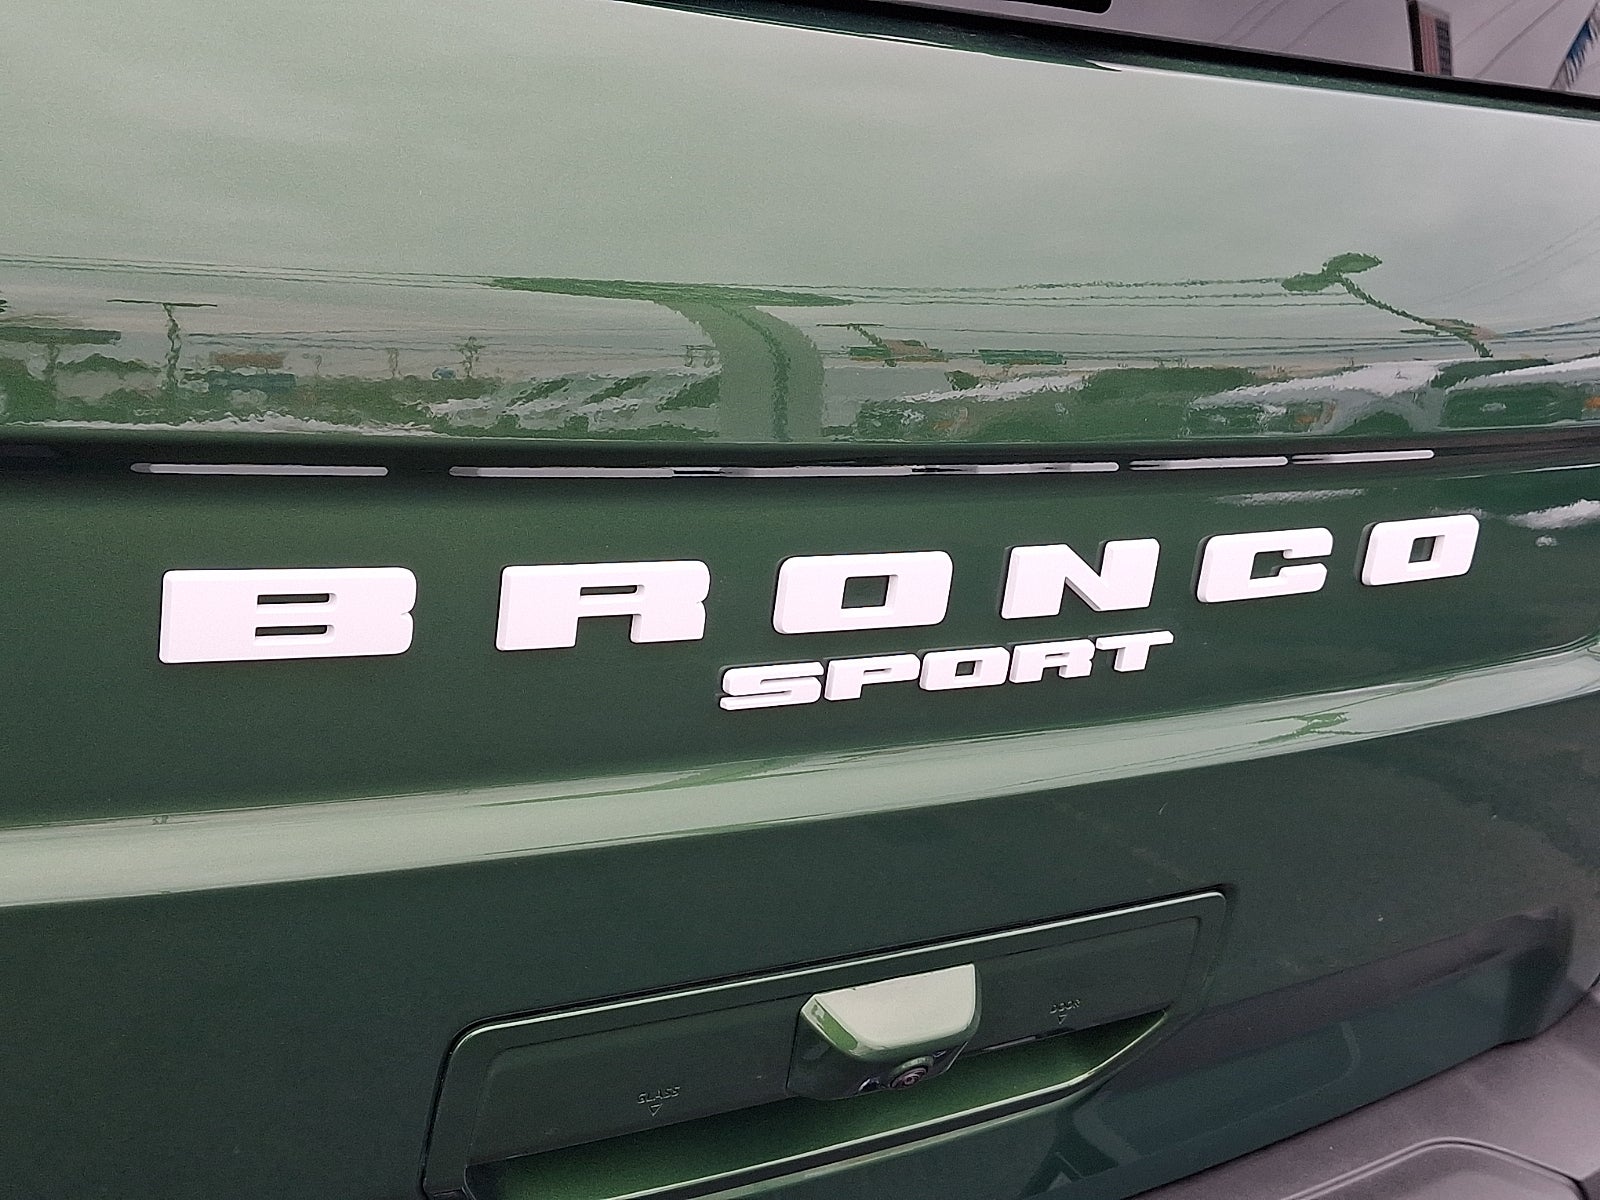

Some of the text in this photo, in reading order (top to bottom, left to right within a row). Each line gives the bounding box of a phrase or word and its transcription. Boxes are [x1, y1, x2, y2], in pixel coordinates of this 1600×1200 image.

[159, 514, 1480, 664] BRONCO
[719, 630, 1174, 711] SPORT
[637, 1086, 681, 1104] GLASS
